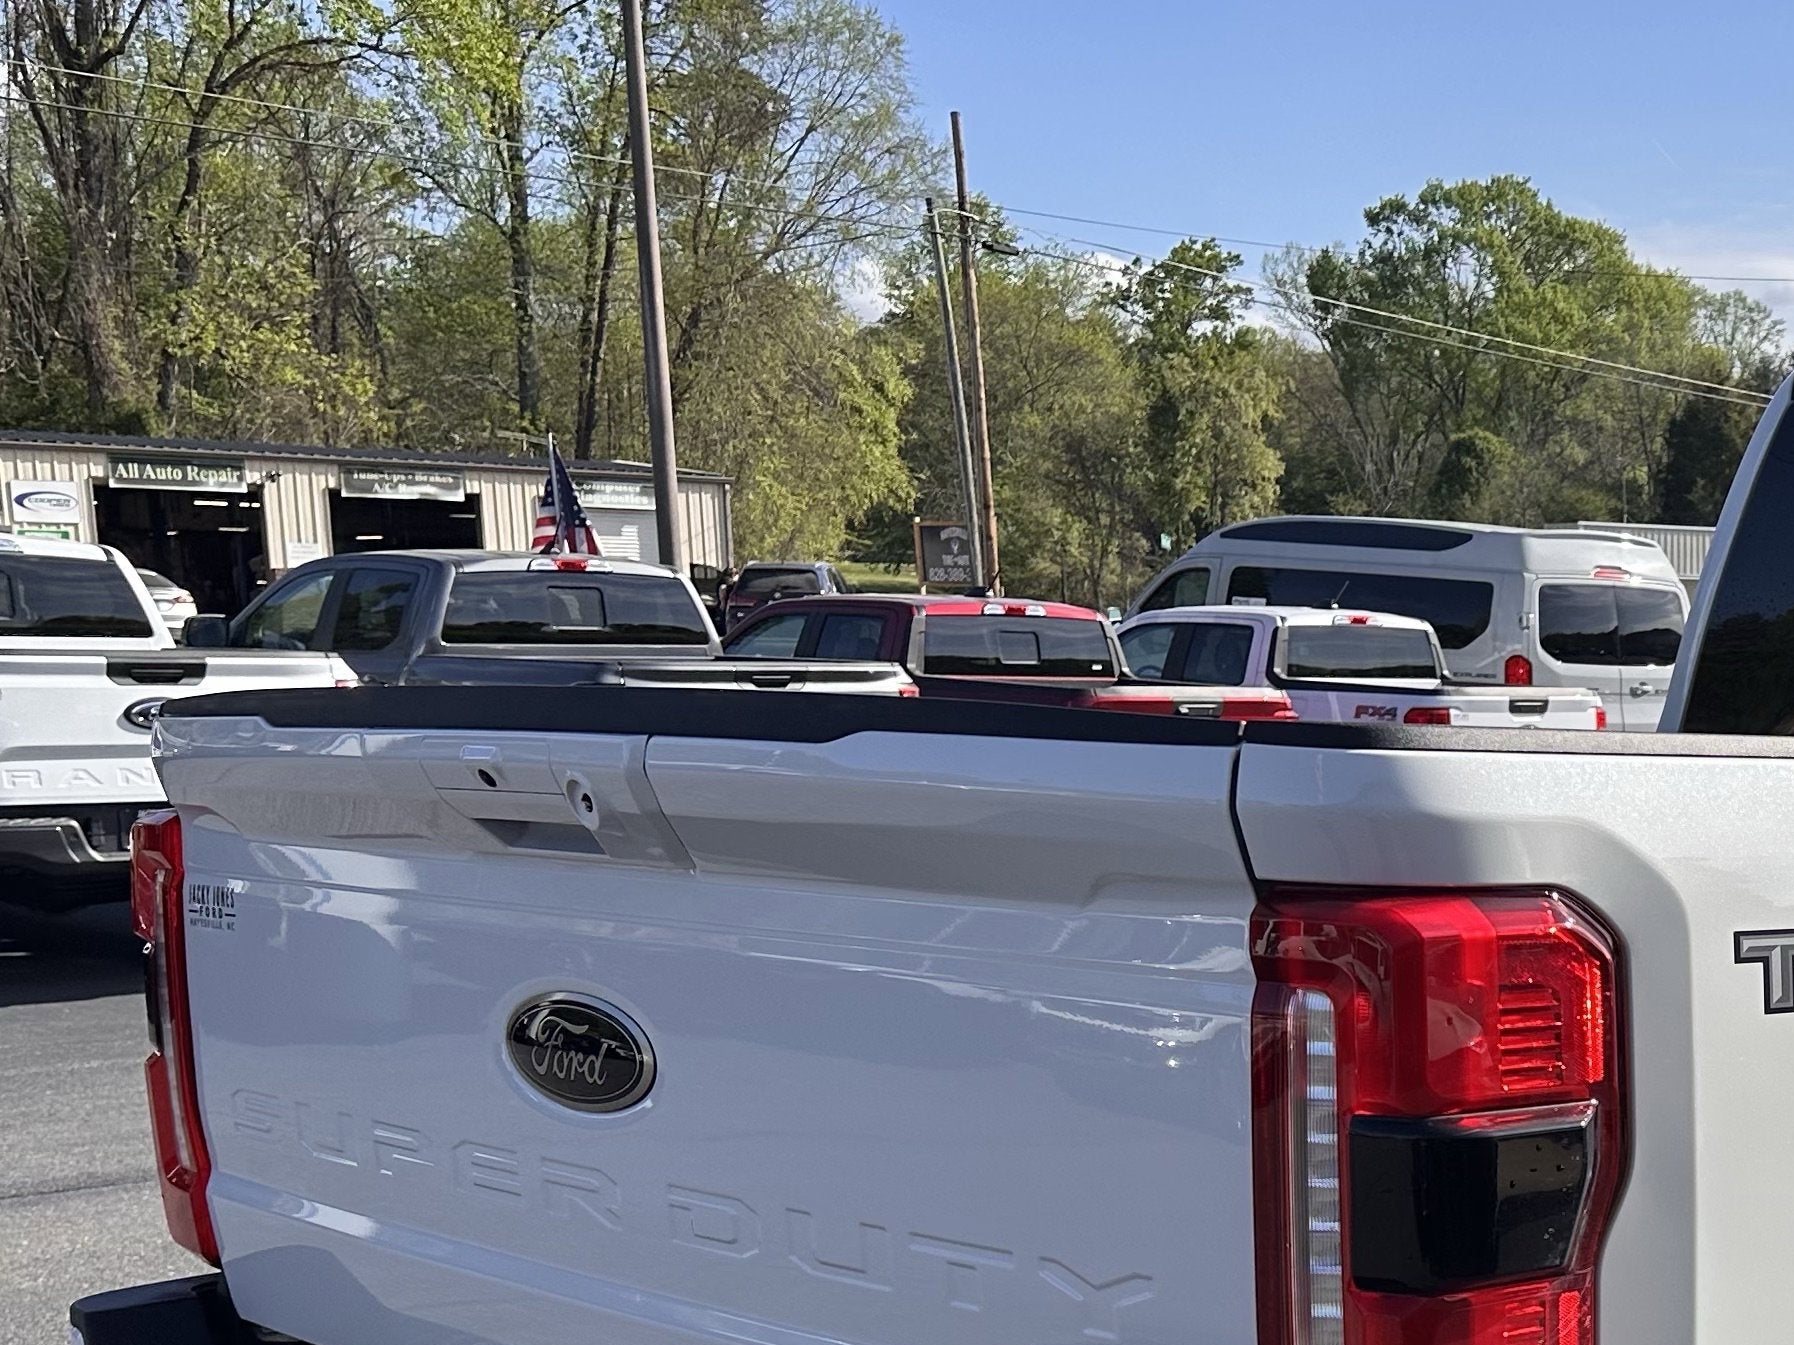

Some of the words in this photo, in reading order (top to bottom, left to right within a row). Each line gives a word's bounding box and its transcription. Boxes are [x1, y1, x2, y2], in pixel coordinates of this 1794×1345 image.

[114, 462, 139, 479] All
[143, 463, 183, 481] Auto
[187, 466, 241, 486] Repair
[581, 490, 649, 505] iagnostics
[1354, 703, 1398, 719] FX4
[188, 884, 210, 905] JACKY
[212, 885, 235, 909] JONES
[199, 905, 223, 919] FORD
[528, 1008, 609, 1086] Ford
[229, 1086, 622, 1230] SUPER
[664, 1182, 1154, 1341] DUTY
